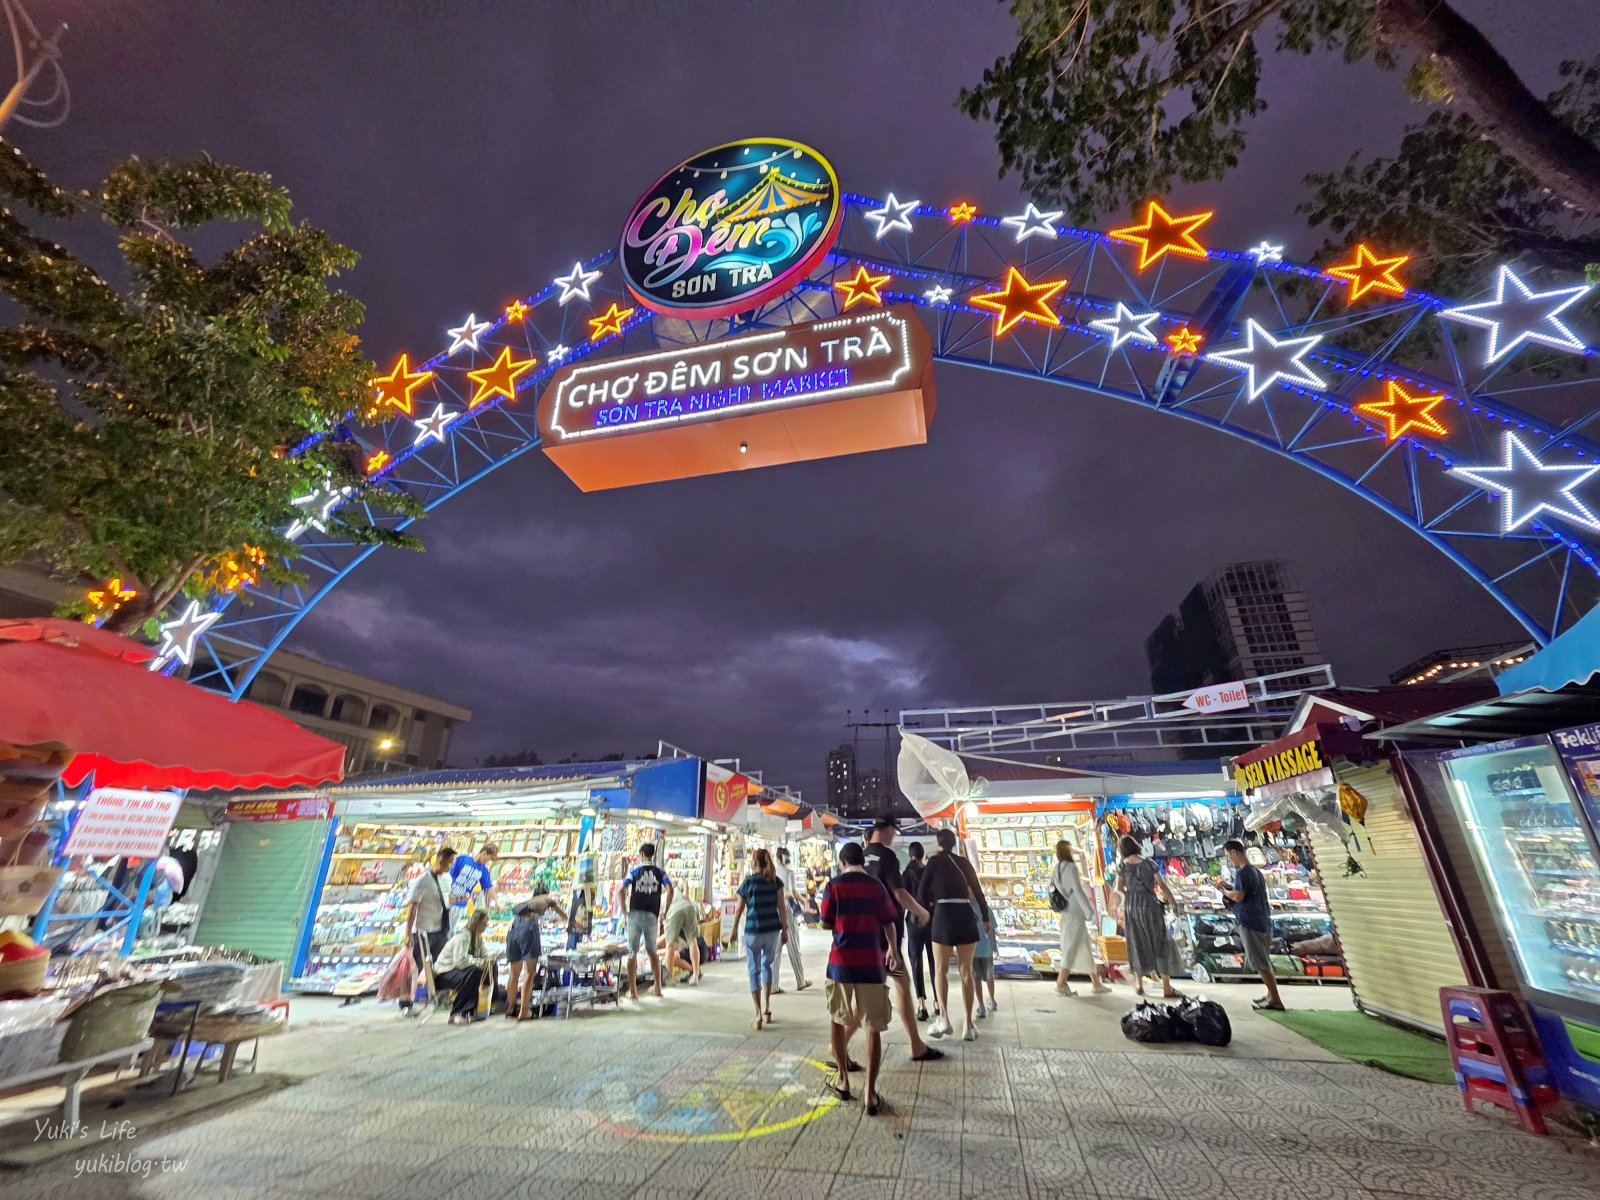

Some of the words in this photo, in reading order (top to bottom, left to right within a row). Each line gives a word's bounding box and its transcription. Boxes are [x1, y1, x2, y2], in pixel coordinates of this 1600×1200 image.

[626, 187, 728, 248] Chợ
[643, 217, 771, 289] Đêm
[729, 260, 773, 287] TRÀ
[568, 372, 639, 408] CHỢ
[645, 360, 722, 394] ĐÊM
[732, 347, 808, 380] SƠN
[820, 325, 892, 364] TRÀ
[761, 368, 851, 400] MARKET
[1195, 694, 1211, 708] WC
[1219, 688, 1246, 704] Toilet
[1244, 760, 1267, 789] SEN
[1264, 740, 1323, 784] MASSAGE
